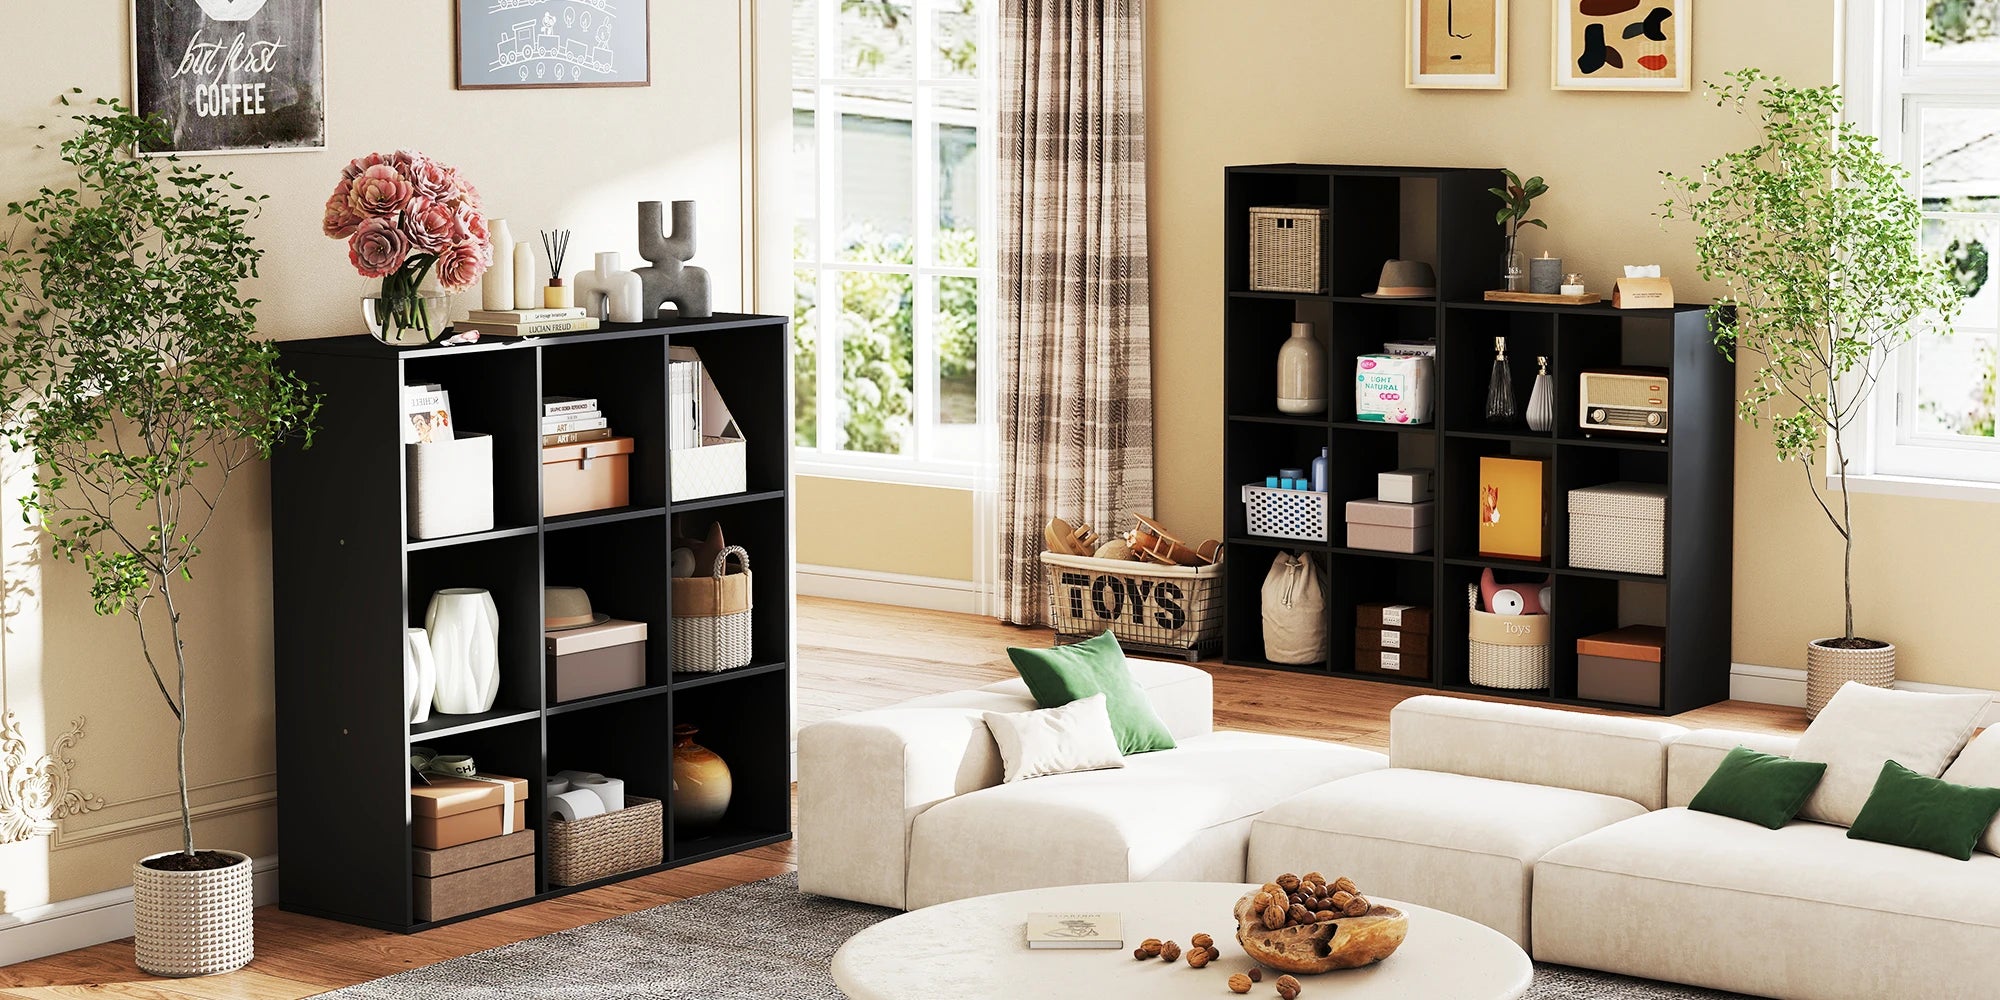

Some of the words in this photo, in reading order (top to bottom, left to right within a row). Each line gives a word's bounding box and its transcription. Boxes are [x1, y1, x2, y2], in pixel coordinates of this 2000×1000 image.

[171, 29, 227, 79] but
[213, 31, 287, 86] first
[195, 82, 266, 117] COFFEE
[528, 324, 551, 333] LUCIAN
[552, 322, 572, 331] FREUD
[1365, 383, 1399, 391] NATURAL
[556, 423, 567, 432] ART
[557, 434, 569, 444] ART
[1061, 572, 1186, 630] TOYS
[1503, 621, 1531, 637] Toys
